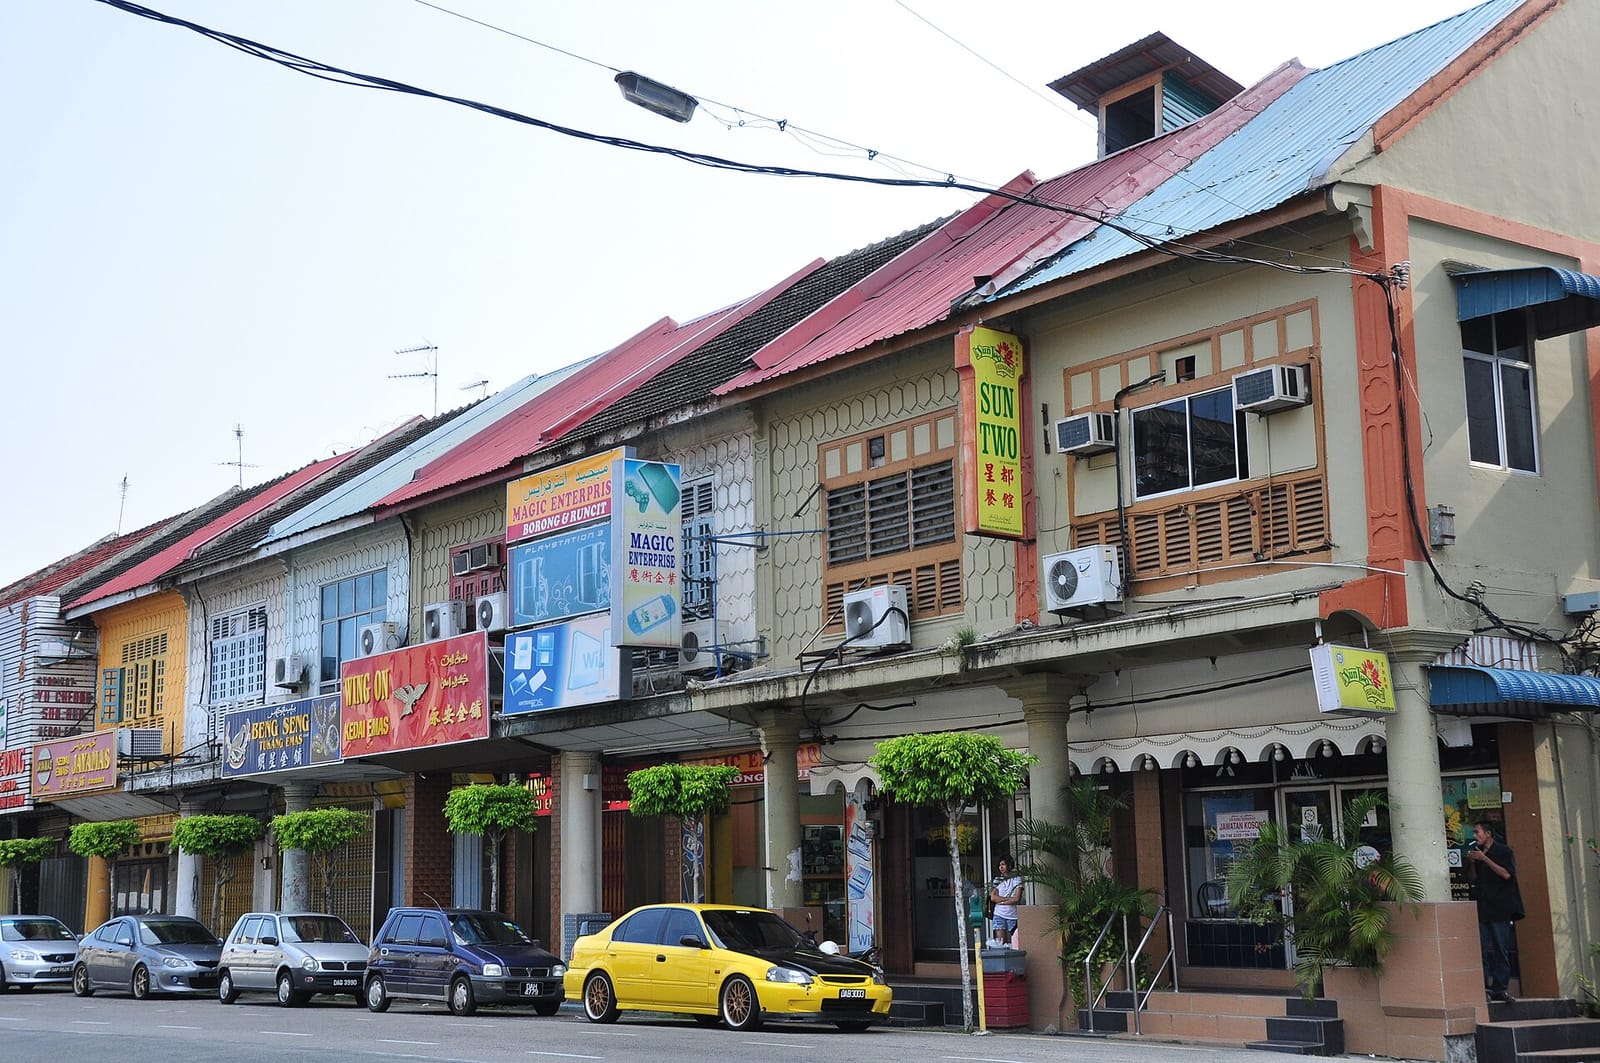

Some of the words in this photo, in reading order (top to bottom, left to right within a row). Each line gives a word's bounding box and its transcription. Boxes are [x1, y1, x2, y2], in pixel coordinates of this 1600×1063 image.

[980, 381, 1014, 419] SUN
[980, 422, 1017, 460] TWO
[983, 463, 1014, 487] 星都
[513, 499, 546, 522] MAGIC
[523, 515, 560, 536] BORONG
[562, 512, 570, 524] &
[570, 501, 608, 522] RUNCIT
[630, 532, 674, 552] MAGIC
[628, 551, 676, 568] ENTERPRISE
[344, 673, 371, 707] WING
[374, 670, 390, 702] ON
[252, 719, 278, 740] BENG
[282, 714, 310, 735] SENG
[344, 718, 366, 741] KEDAI
[368, 716, 390, 737] EMAS
[260, 738, 283, 751] TUKANG
[286, 734, 303, 747] EMAS
[72, 748, 110, 774] JAYAMAS
[1220, 822, 1243, 830] JAWATAN
